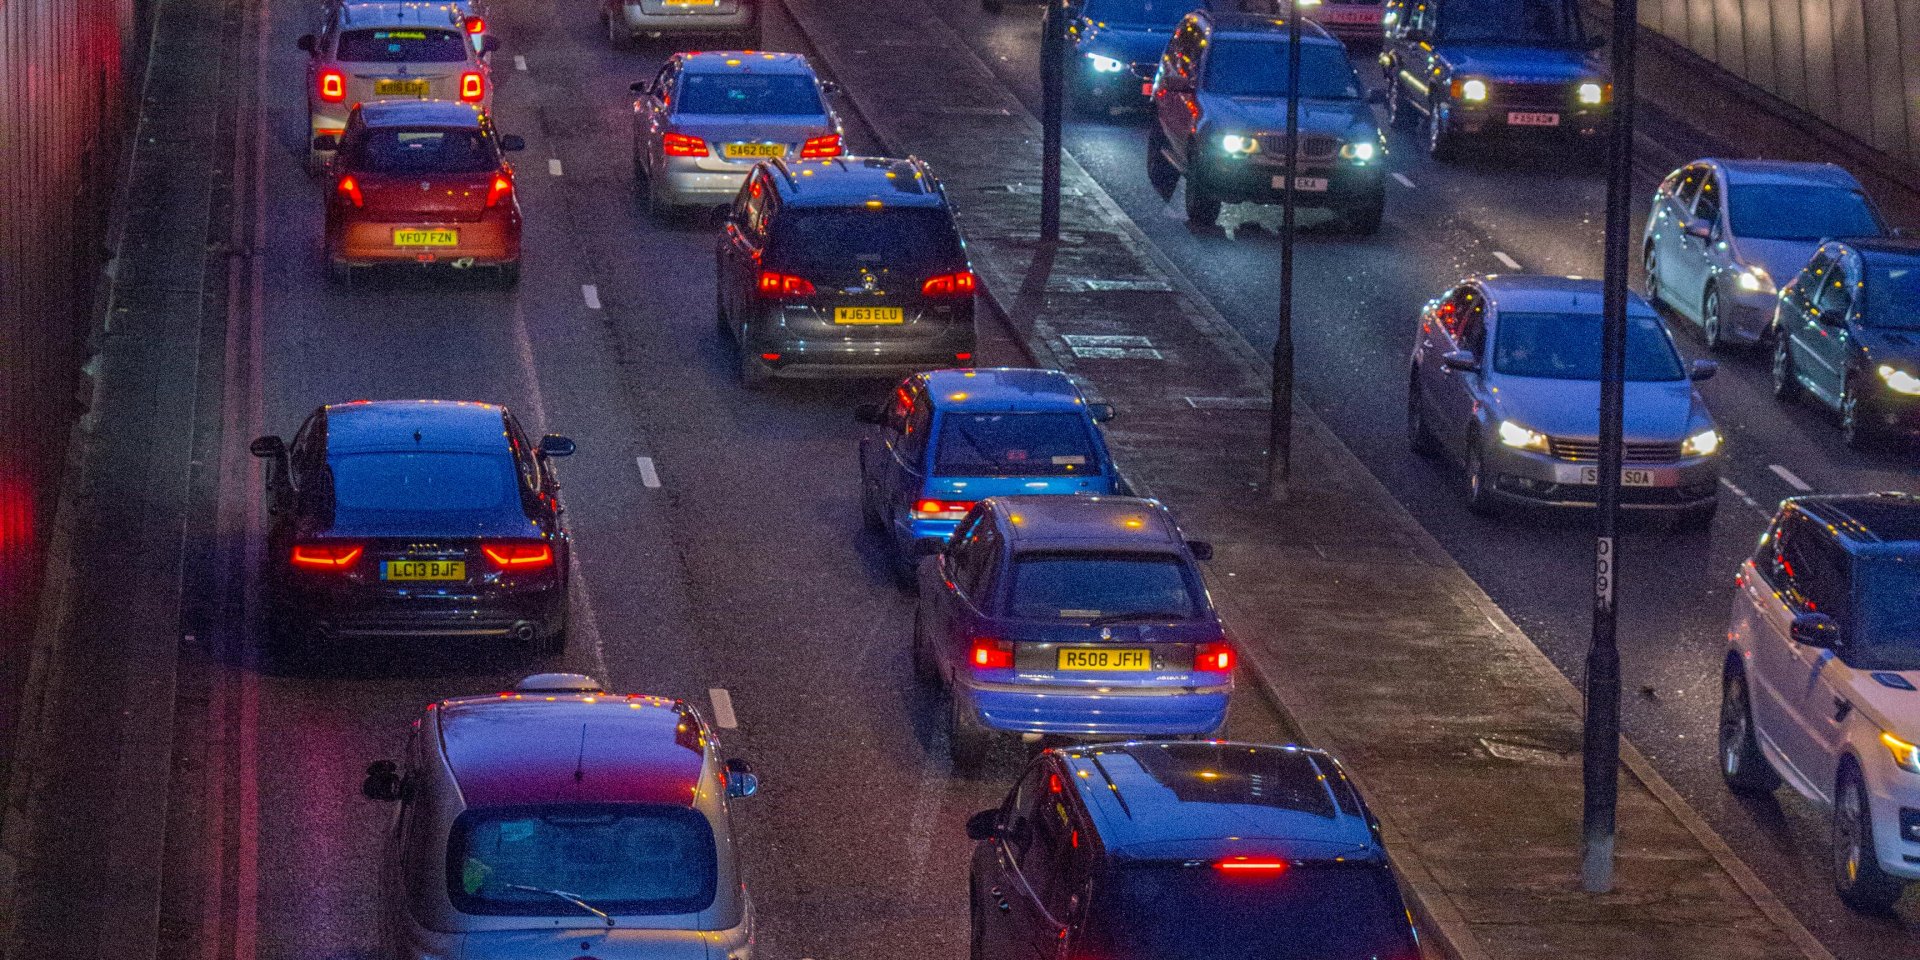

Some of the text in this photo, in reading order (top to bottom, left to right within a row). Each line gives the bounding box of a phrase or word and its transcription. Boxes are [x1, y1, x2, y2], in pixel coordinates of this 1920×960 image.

[730, 145, 757, 156] SA62
[1297, 179, 1316, 188] EKA
[399, 232, 452, 243] YF07 FZN
[840, 309, 897, 320] WJ63 ELU
[1625, 471, 1649, 484] SOA
[393, 563, 460, 577] LC13 BJF
[1067, 652, 1143, 667] R508 JFH
